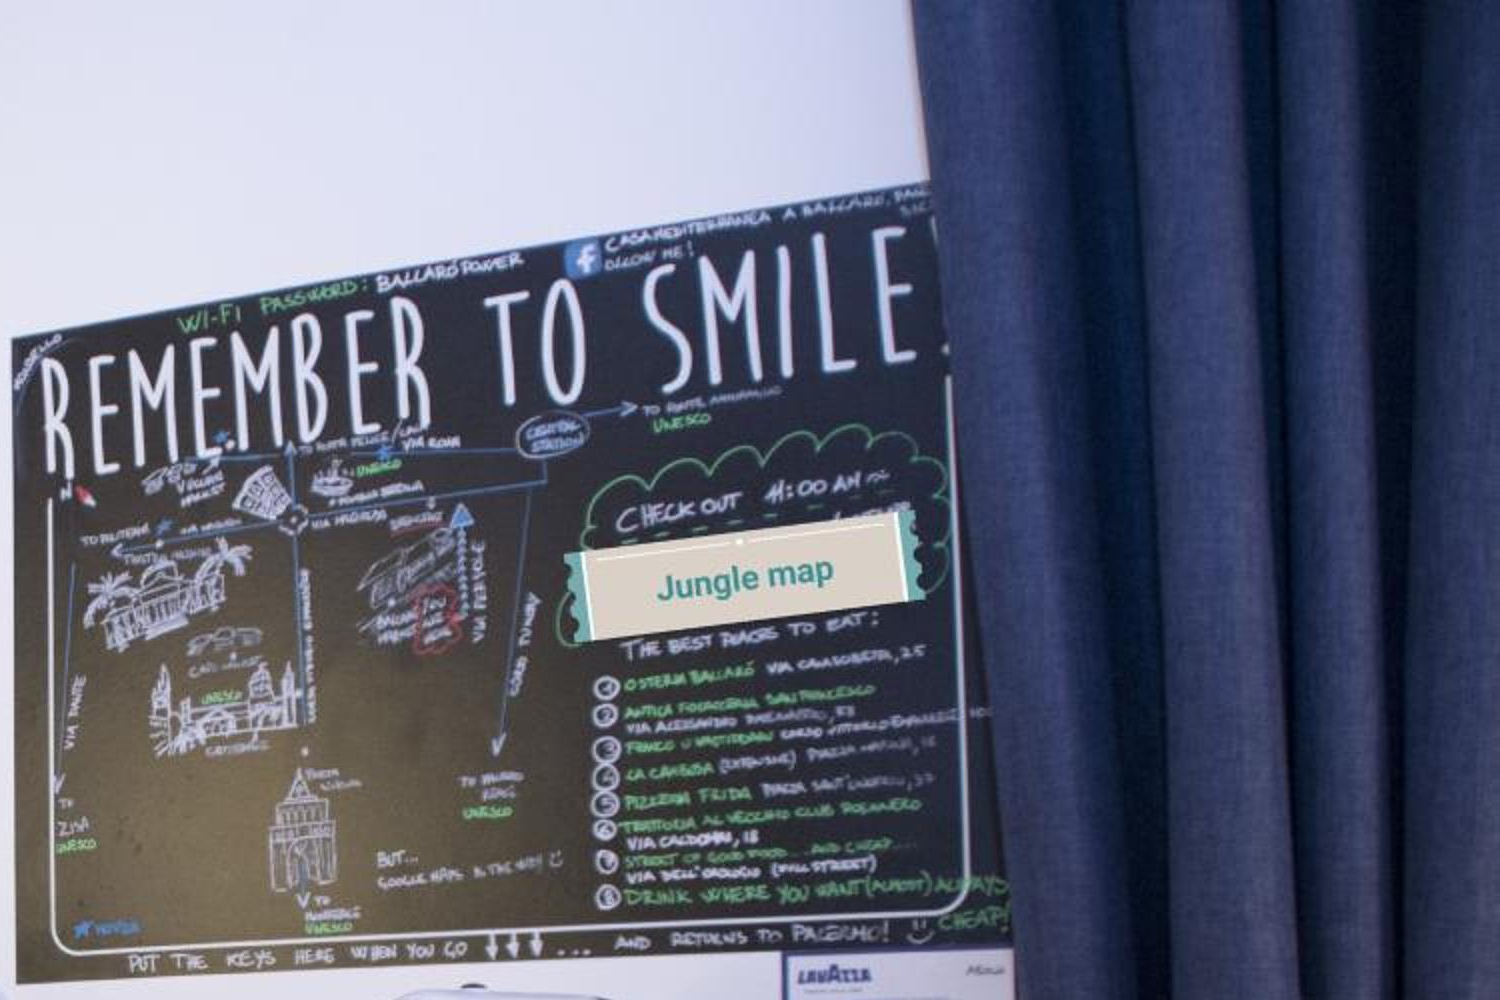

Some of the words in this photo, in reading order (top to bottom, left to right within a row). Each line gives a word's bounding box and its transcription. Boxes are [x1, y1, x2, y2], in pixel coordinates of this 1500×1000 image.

[177, 301, 242, 334] WI-FI
[41, 296, 431, 481] REMEMBER
[482, 278, 586, 407] TO
[643, 216, 951, 396] SMILE
[653, 413, 711, 434] UNESCO
[615, 502, 696, 534] CHECK
[700, 490, 743, 516] OUT
[657, 564, 759, 603] Jungle
[769, 558, 835, 589] map
[620, 638, 662, 662] THE
[667, 634, 713, 654] BEST
[787, 621, 817, 637] TO
[765, 661, 794, 676] VIA
[64, 723, 78, 750] VIA
[463, 805, 512, 820] UNESCO
[627, 836, 657, 850] VIA
[626, 871, 657, 884] VIA
[623, 888, 693, 905] DRINK
[699, 884, 772, 903] WHERE
[776, 883, 811, 904] YOU
[128, 954, 160, 973] PUT
[170, 953, 208, 970] THE
[226, 950, 276, 970] KEYS
[294, 948, 335, 965] HERE
[350, 944, 398, 961] WHEN
[406, 942, 435, 958] YOU
[444, 941, 469, 957] GO
[614, 935, 652, 951] AND
[758, 929, 784, 943] TO
[797, 963, 872, 985] LAVAZZA
